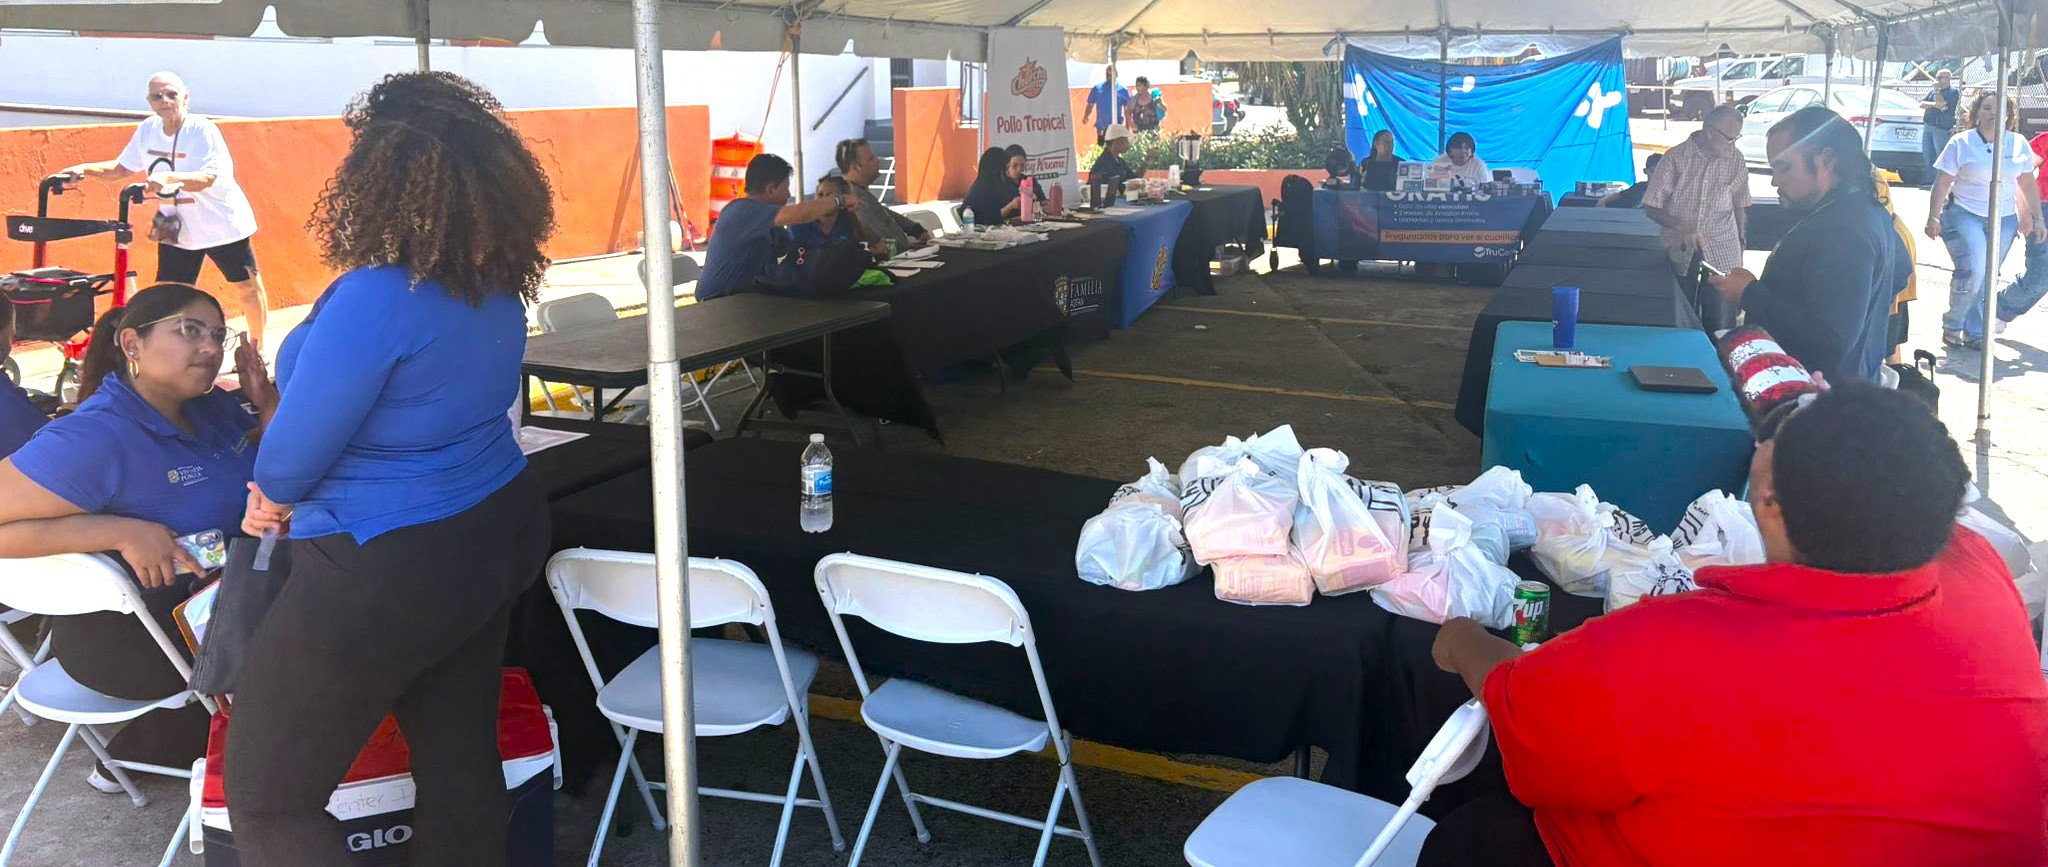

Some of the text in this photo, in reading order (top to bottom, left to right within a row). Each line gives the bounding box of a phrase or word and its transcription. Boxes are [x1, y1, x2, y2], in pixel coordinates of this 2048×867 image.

[997, 113, 1066, 134] Pollo Tropical
[335, 792, 386, 814] enter
[347, 824, 413, 852] GLO
